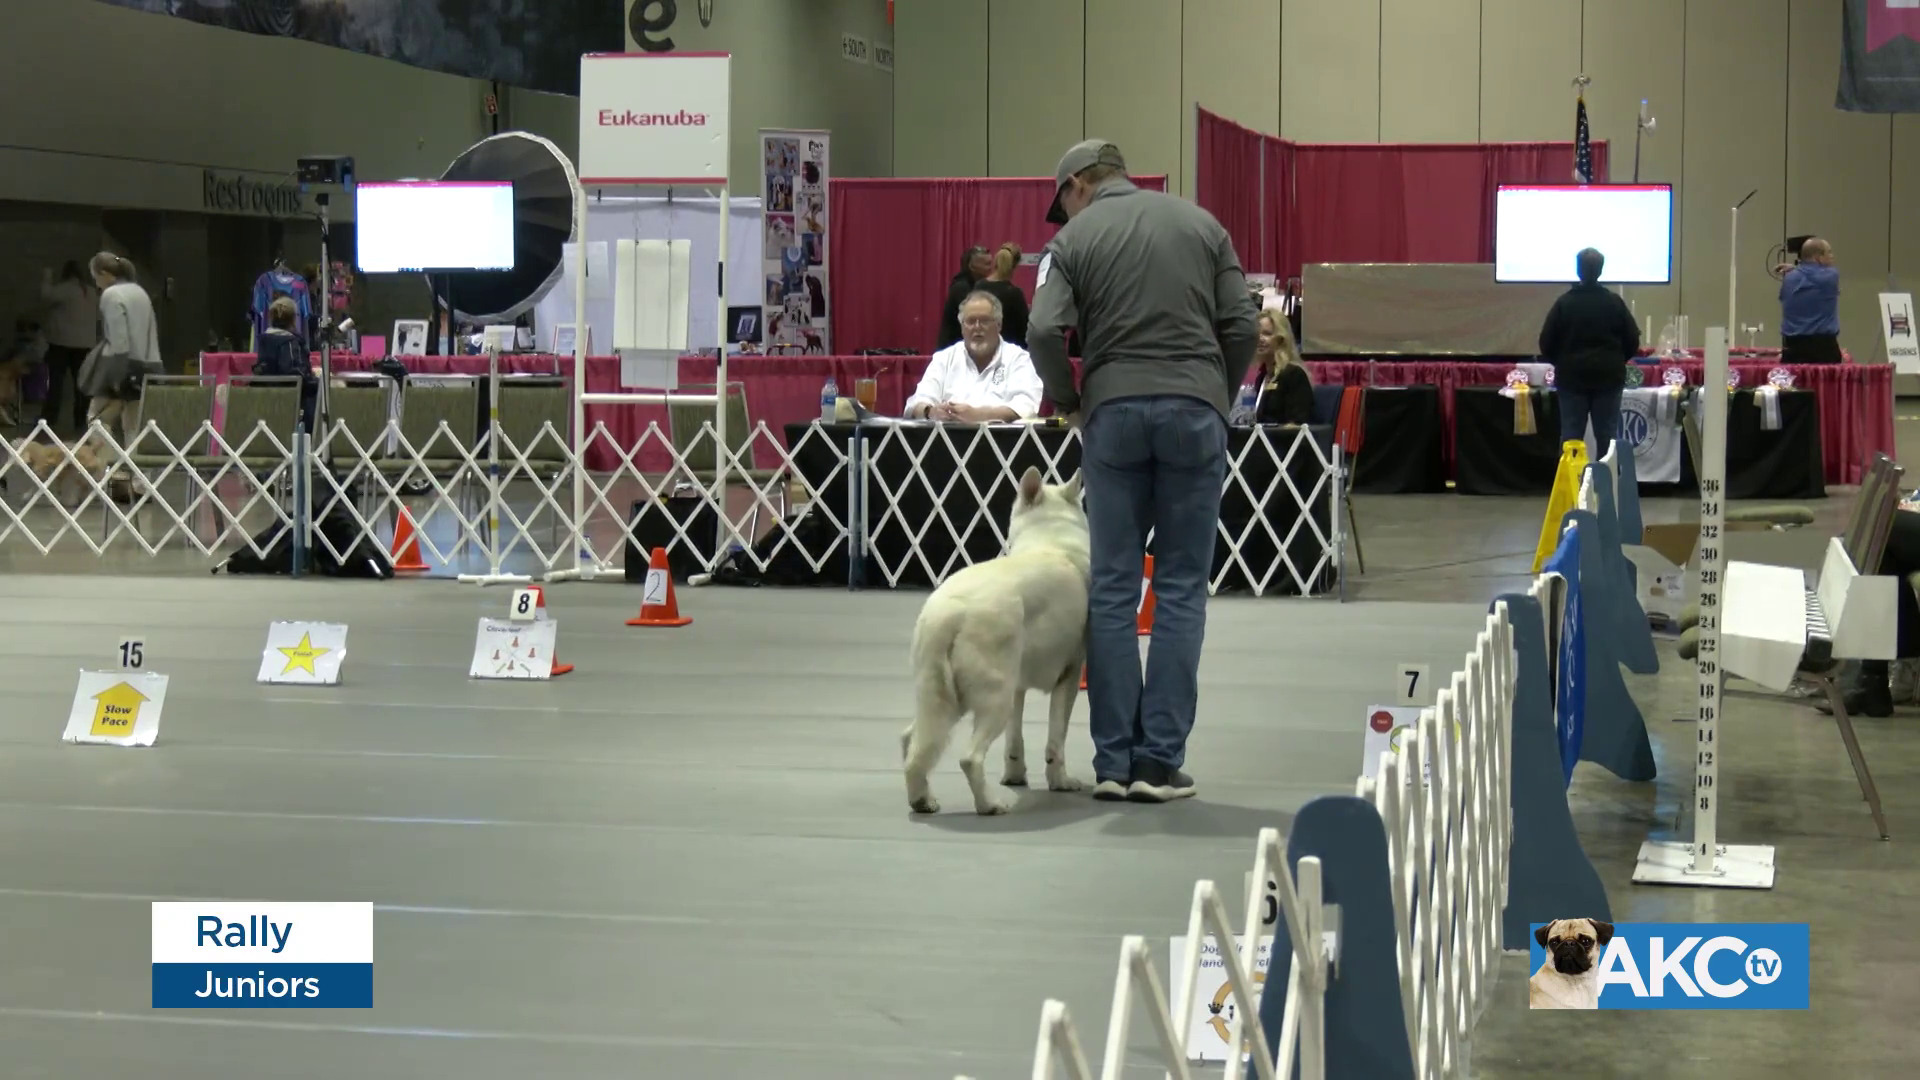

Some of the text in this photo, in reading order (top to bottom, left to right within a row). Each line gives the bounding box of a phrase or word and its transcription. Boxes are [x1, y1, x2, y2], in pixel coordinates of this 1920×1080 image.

[598, 109, 706, 127] Eukanuba
[203, 168, 301, 217] Restrooms
[1703, 480, 1719, 492] 36
[1702, 526, 1718, 538] 32
[1701, 548, 1717, 560] 30
[1701, 571, 1717, 584] 28
[646, 572, 661, 601] 2
[517, 593, 530, 614] 8
[1700, 593, 1716, 606] 26
[1700, 639, 1715, 652] 22
[120, 641, 143, 668] 15
[1700, 661, 1715, 674] 20
[1405, 671, 1419, 697] 7
[1700, 684, 1714, 698] 18
[105, 704, 132, 715] Slow
[102, 716, 128, 726] Pace
